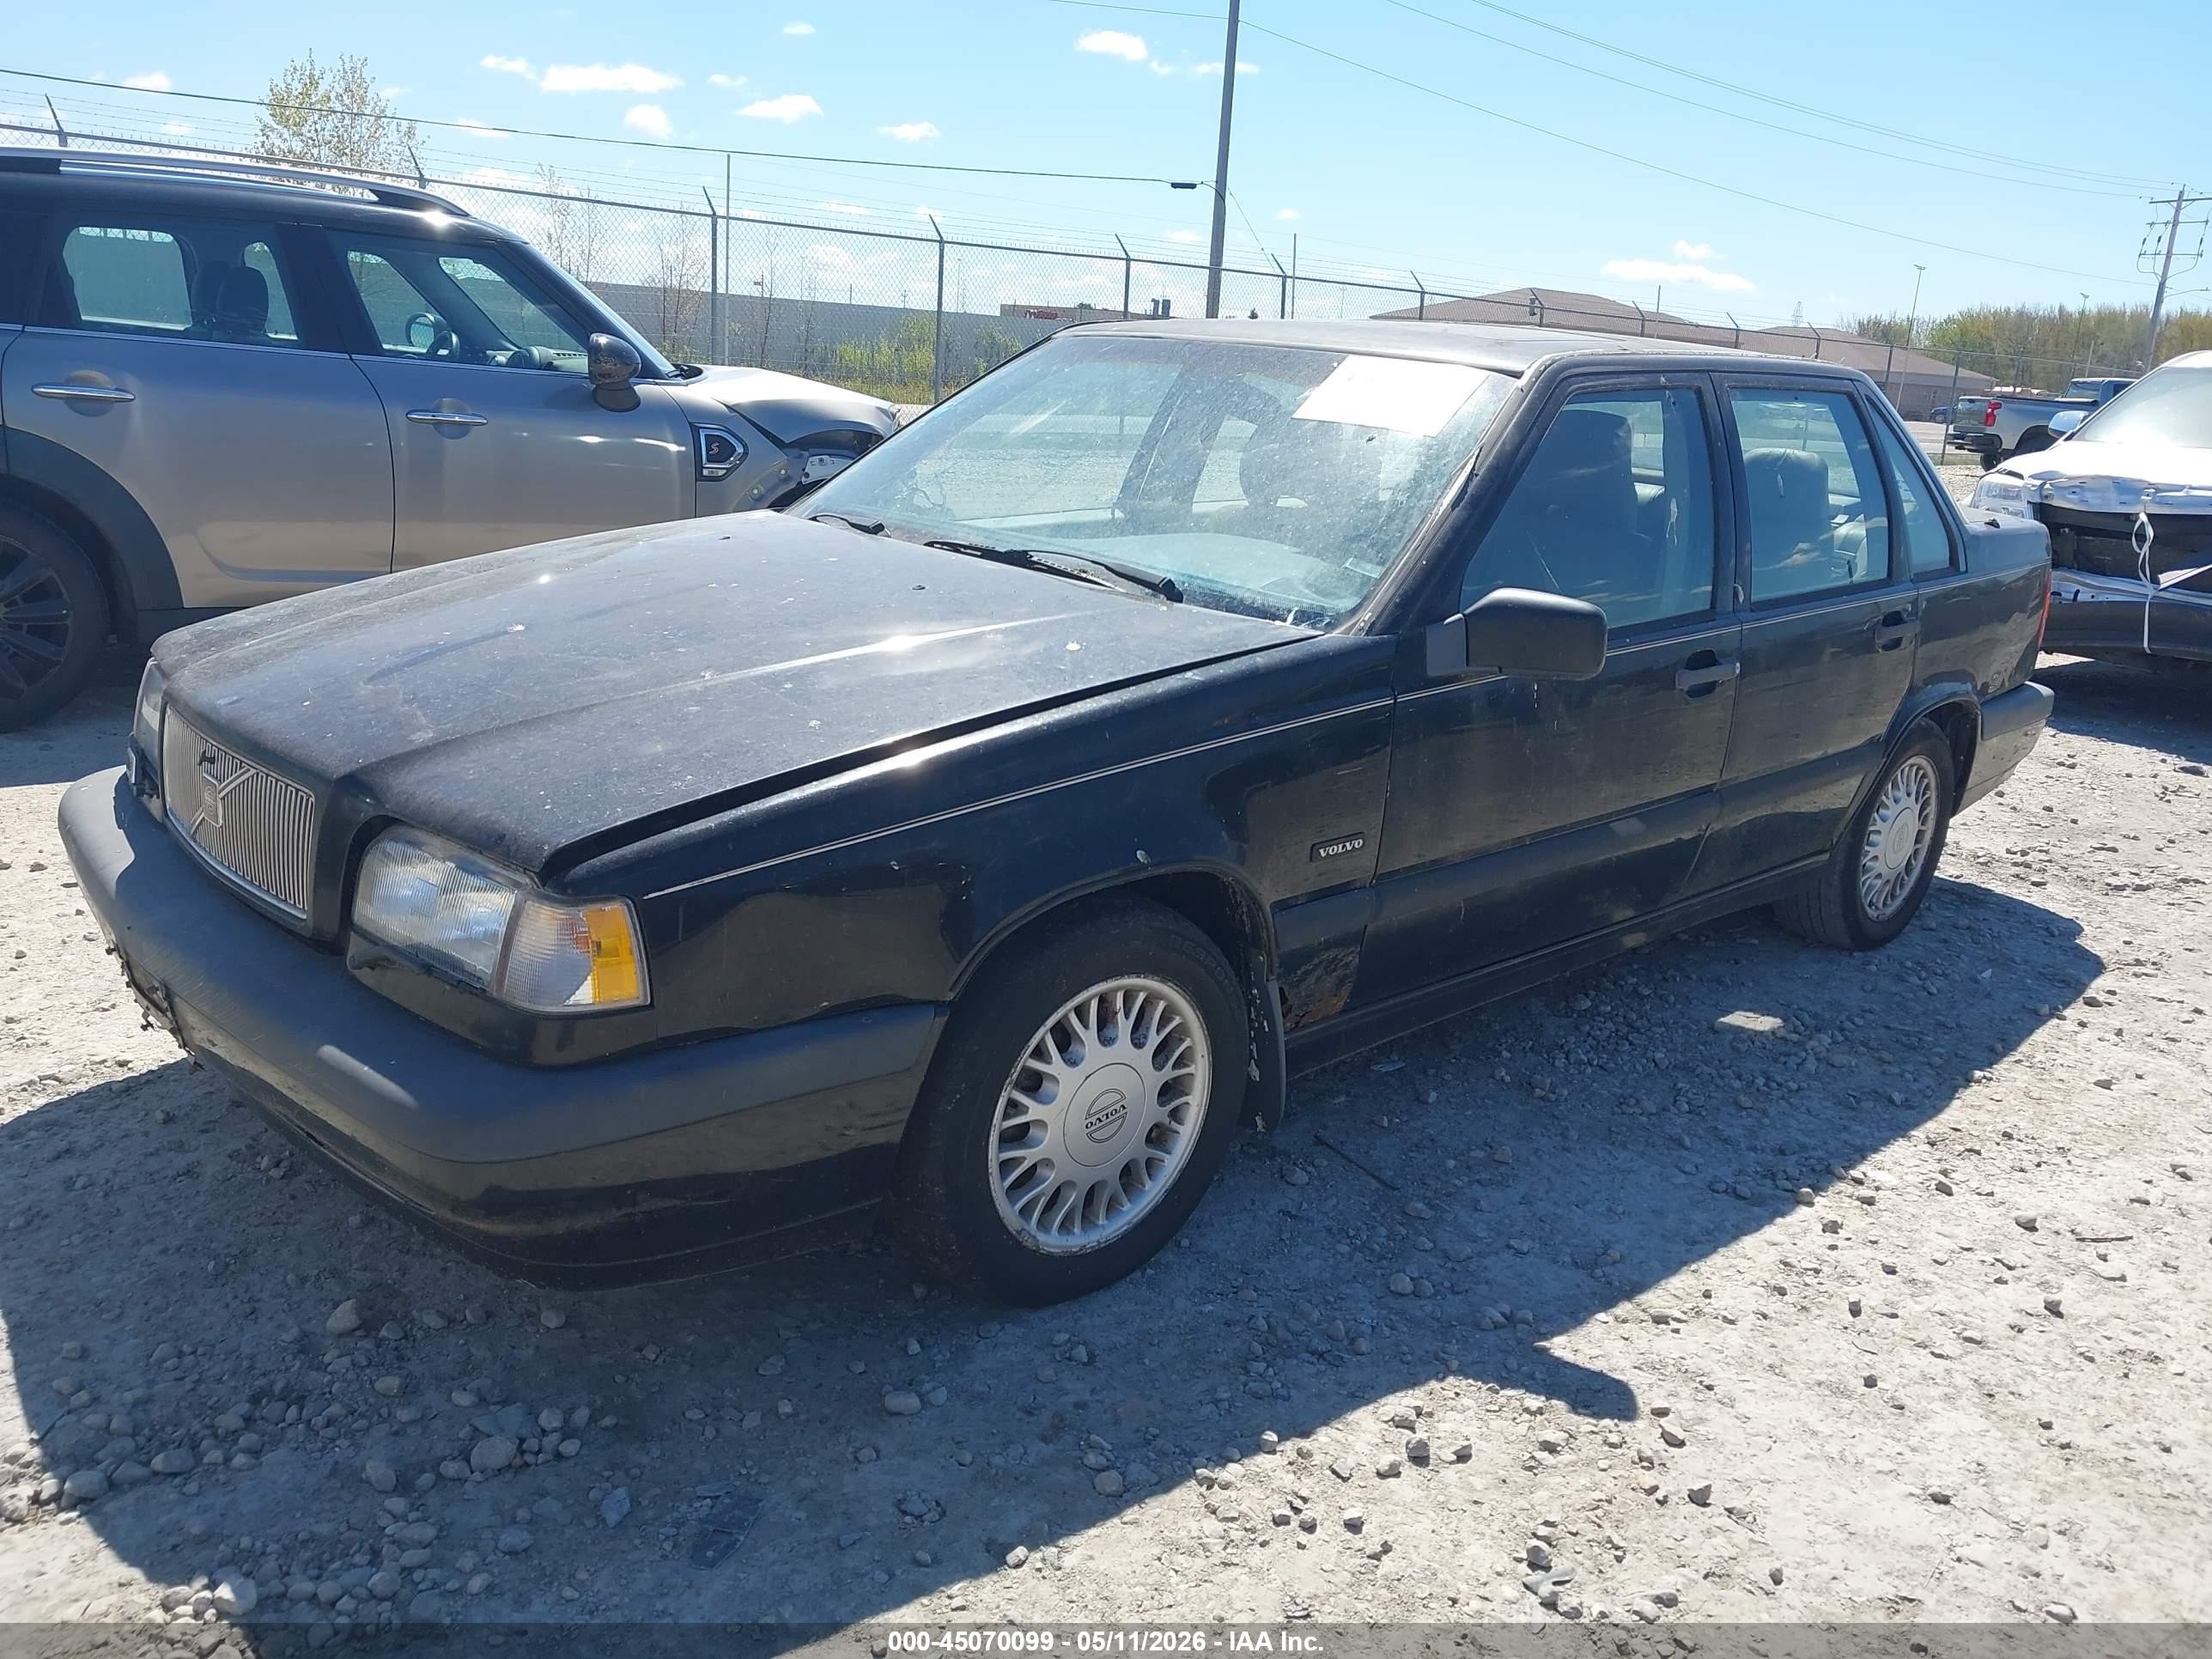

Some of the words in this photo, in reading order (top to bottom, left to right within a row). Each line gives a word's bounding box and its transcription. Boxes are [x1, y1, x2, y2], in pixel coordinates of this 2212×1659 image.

[708, 442, 720, 454] S
[1318, 838, 1364, 858] VOLVO
[1085, 1103, 1127, 1130] VOLVO
